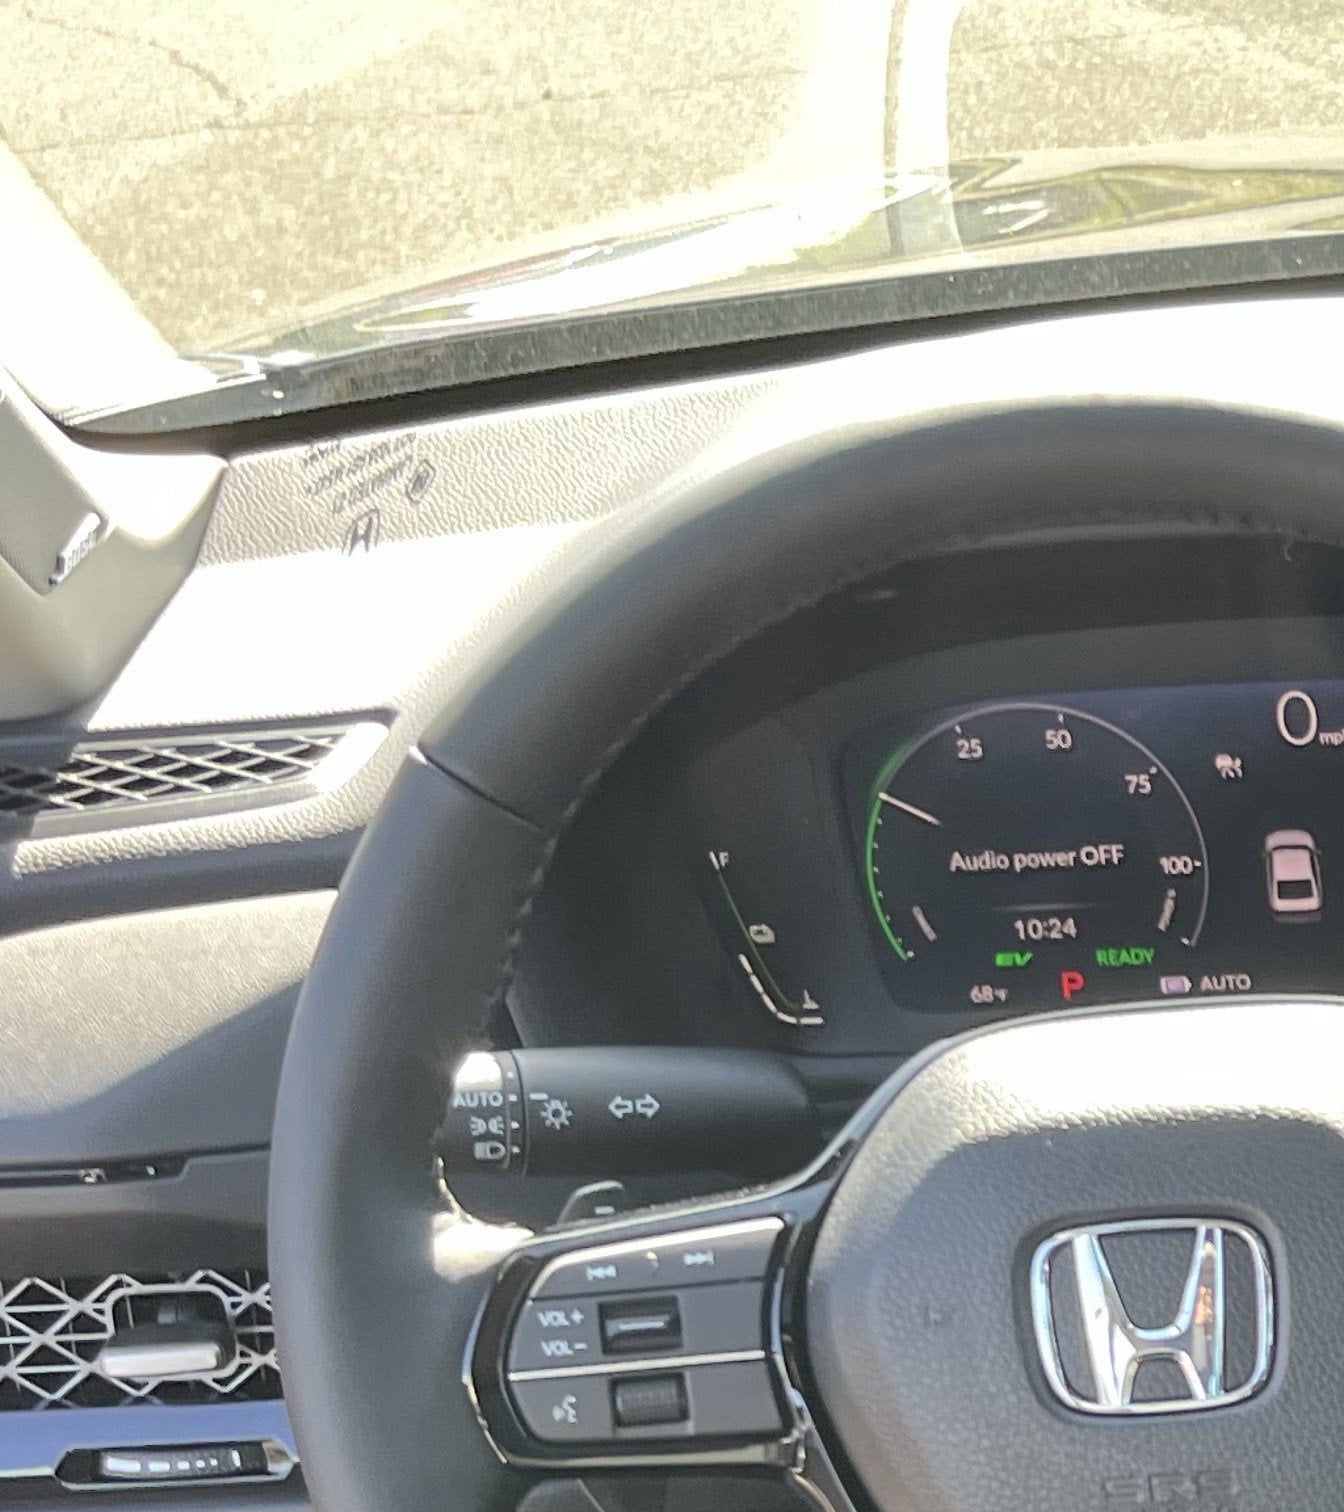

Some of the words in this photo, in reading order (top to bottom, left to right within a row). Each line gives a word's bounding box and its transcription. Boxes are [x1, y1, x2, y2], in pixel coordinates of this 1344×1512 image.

[1276, 690, 1318, 747] 0
[958, 739, 983, 760] 25
[1045, 729, 1072, 750] 50
[1125, 774, 1151, 795] 75
[949, 849, 1008, 873] Audio
[1013, 848, 1076, 872] power
[1080, 845, 1124, 866] OFF
[1160, 855, 1194, 876] 100
[1014, 918, 1077, 940] 10:24
[1095, 947, 1155, 967] READY
[1060, 970, 1086, 1001] P
[1199, 973, 1252, 992] AUTO
[452, 1091, 503, 1108] AUTO
[537, 1309, 571, 1327] VOL
[541, 1339, 574, 1357] VOL
